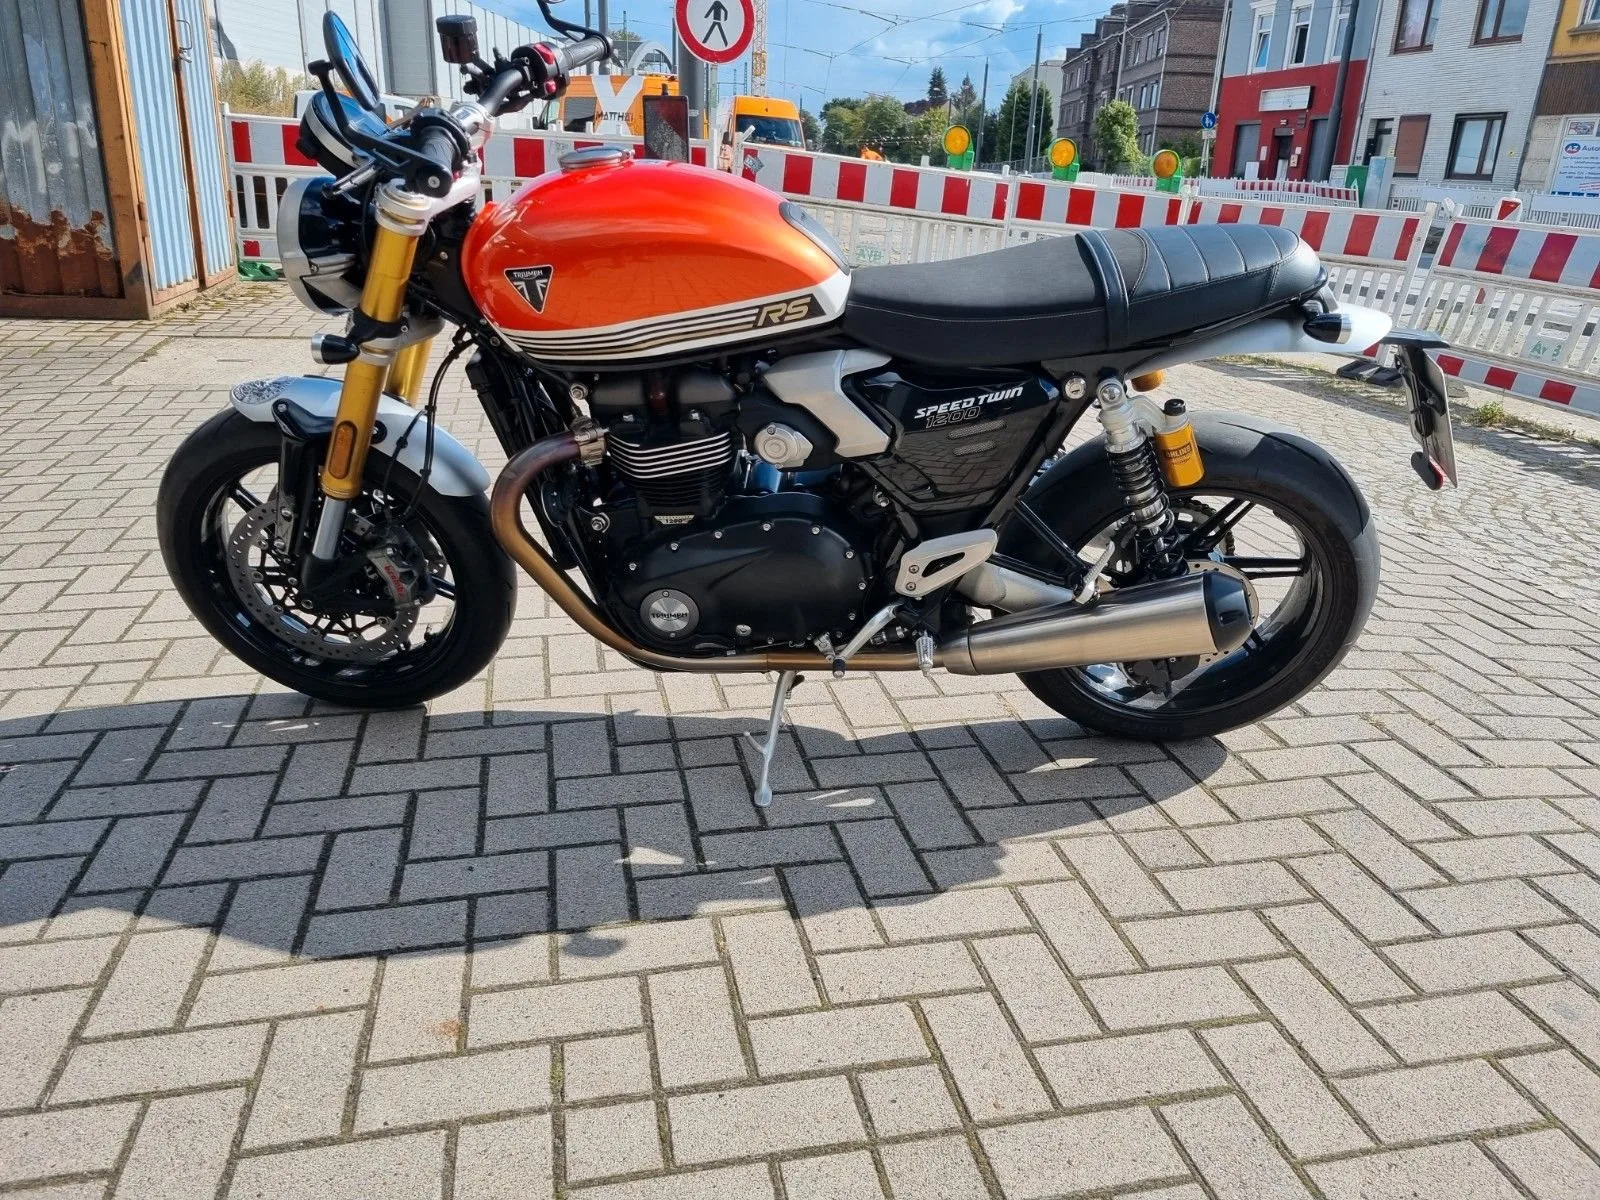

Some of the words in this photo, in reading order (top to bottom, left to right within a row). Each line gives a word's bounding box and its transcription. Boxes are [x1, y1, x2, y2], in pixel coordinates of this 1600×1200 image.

[513, 270, 543, 279] TRIUMPH
[757, 296, 812, 327] RS
[914, 397, 975, 419] SPEED
[978, 386, 1024, 405] TWIN
[926, 406, 981, 429] 1200
[651, 612, 688, 620] TRIUMPH
